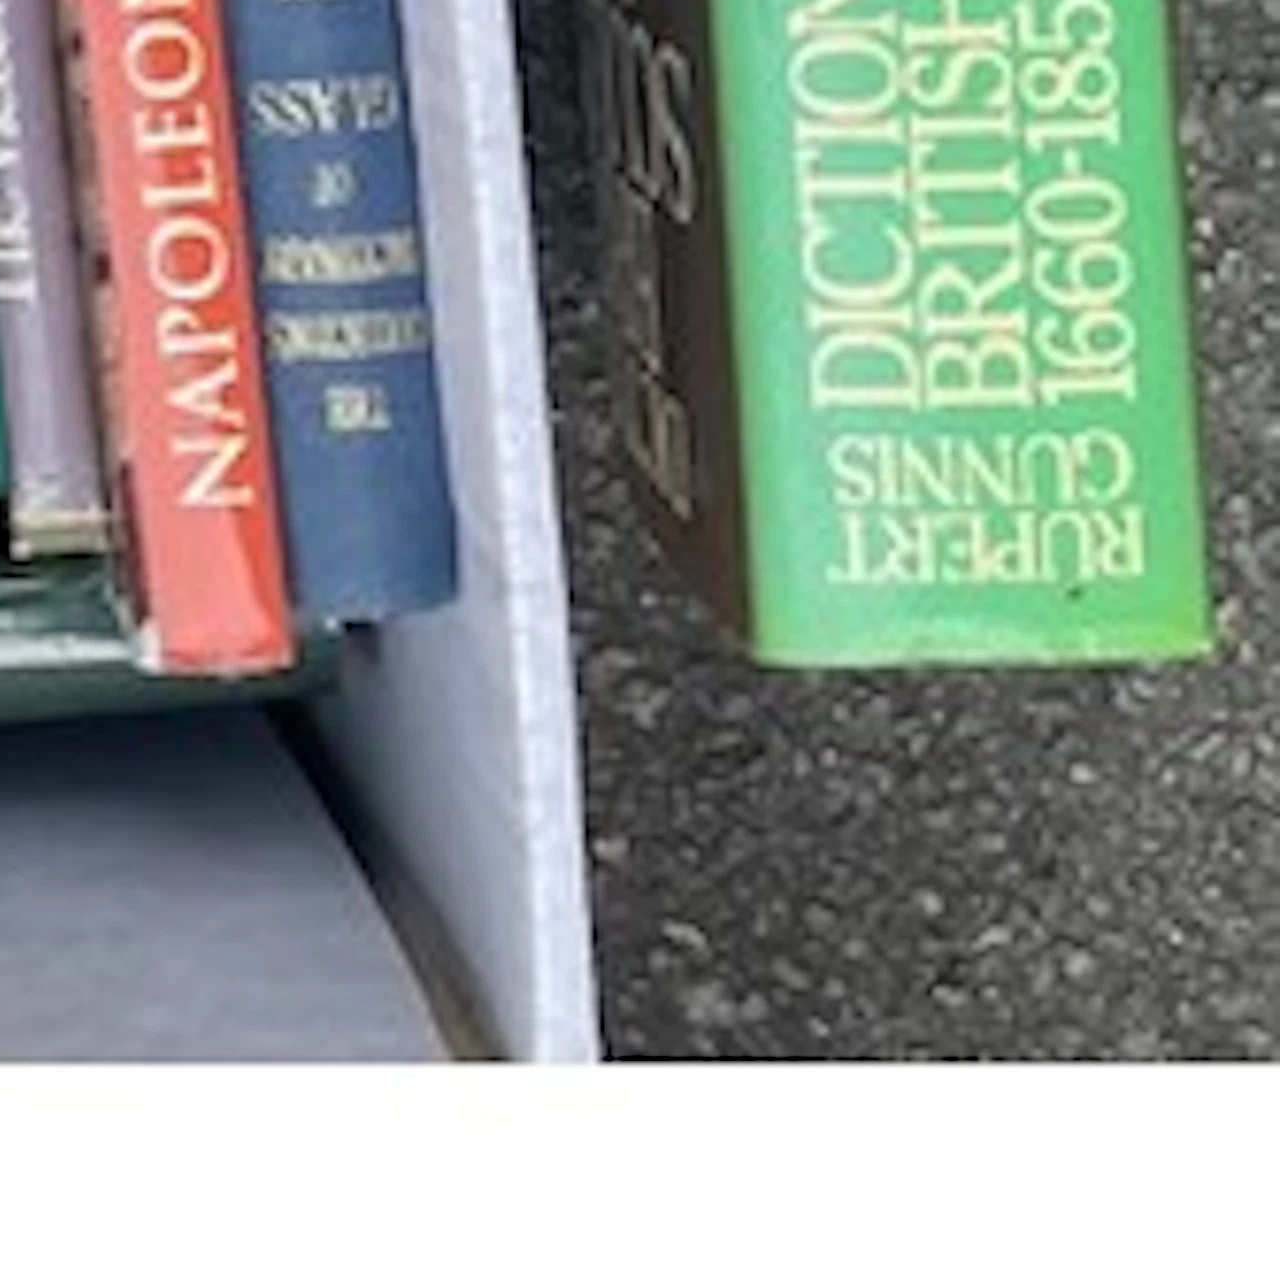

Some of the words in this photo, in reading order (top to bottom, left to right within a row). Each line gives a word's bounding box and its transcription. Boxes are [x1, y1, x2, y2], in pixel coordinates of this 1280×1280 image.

[251, 78, 400, 133] GLASS
[831, 430, 1134, 506] GUNNIS
[828, 506, 1145, 586] RUPERT
